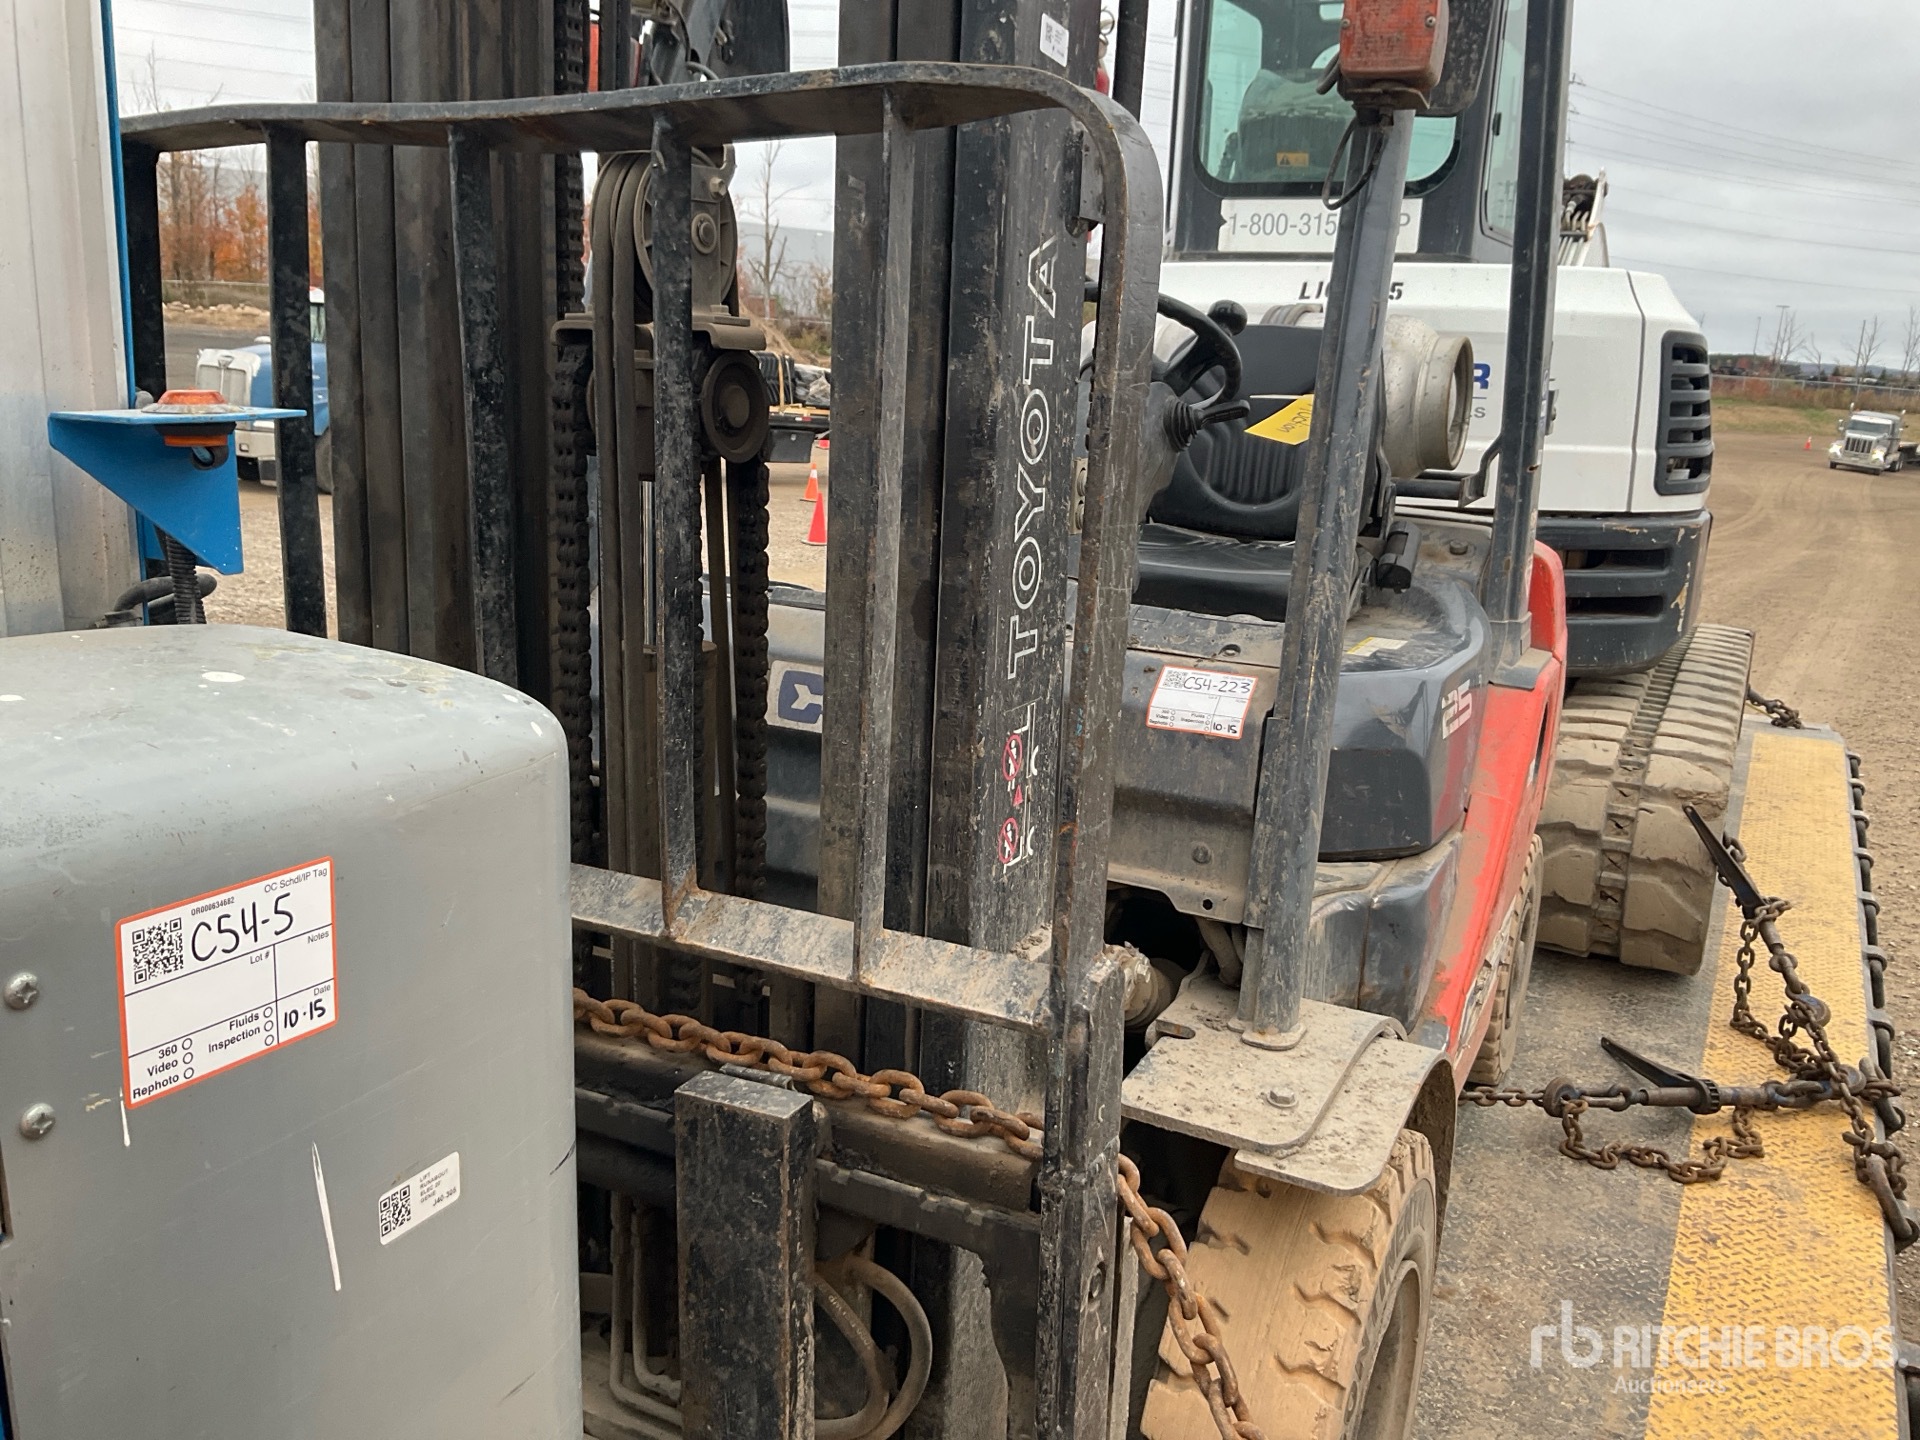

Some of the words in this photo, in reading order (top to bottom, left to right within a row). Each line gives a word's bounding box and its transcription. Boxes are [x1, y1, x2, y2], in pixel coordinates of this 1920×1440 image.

[1007, 233, 1059, 680] TOYOTA
[1183, 676, 1251, 694] C54-223
[1441, 678, 1473, 740] 25
[264, 882, 277, 894] OC
[313, 867, 329, 881] Tag
[191, 892, 294, 962] C54-5
[307, 930, 330, 944] Notes
[249, 953, 264, 965] Lot
[264, 951, 271, 960] #
[313, 983, 332, 997] Date
[229, 1011, 260, 1031] Fluids
[208, 1026, 261, 1053] Inspection
[158, 1044, 178, 1060] 360
[147, 1057, 179, 1077] Video
[132, 1073, 180, 1099] Rephoto
